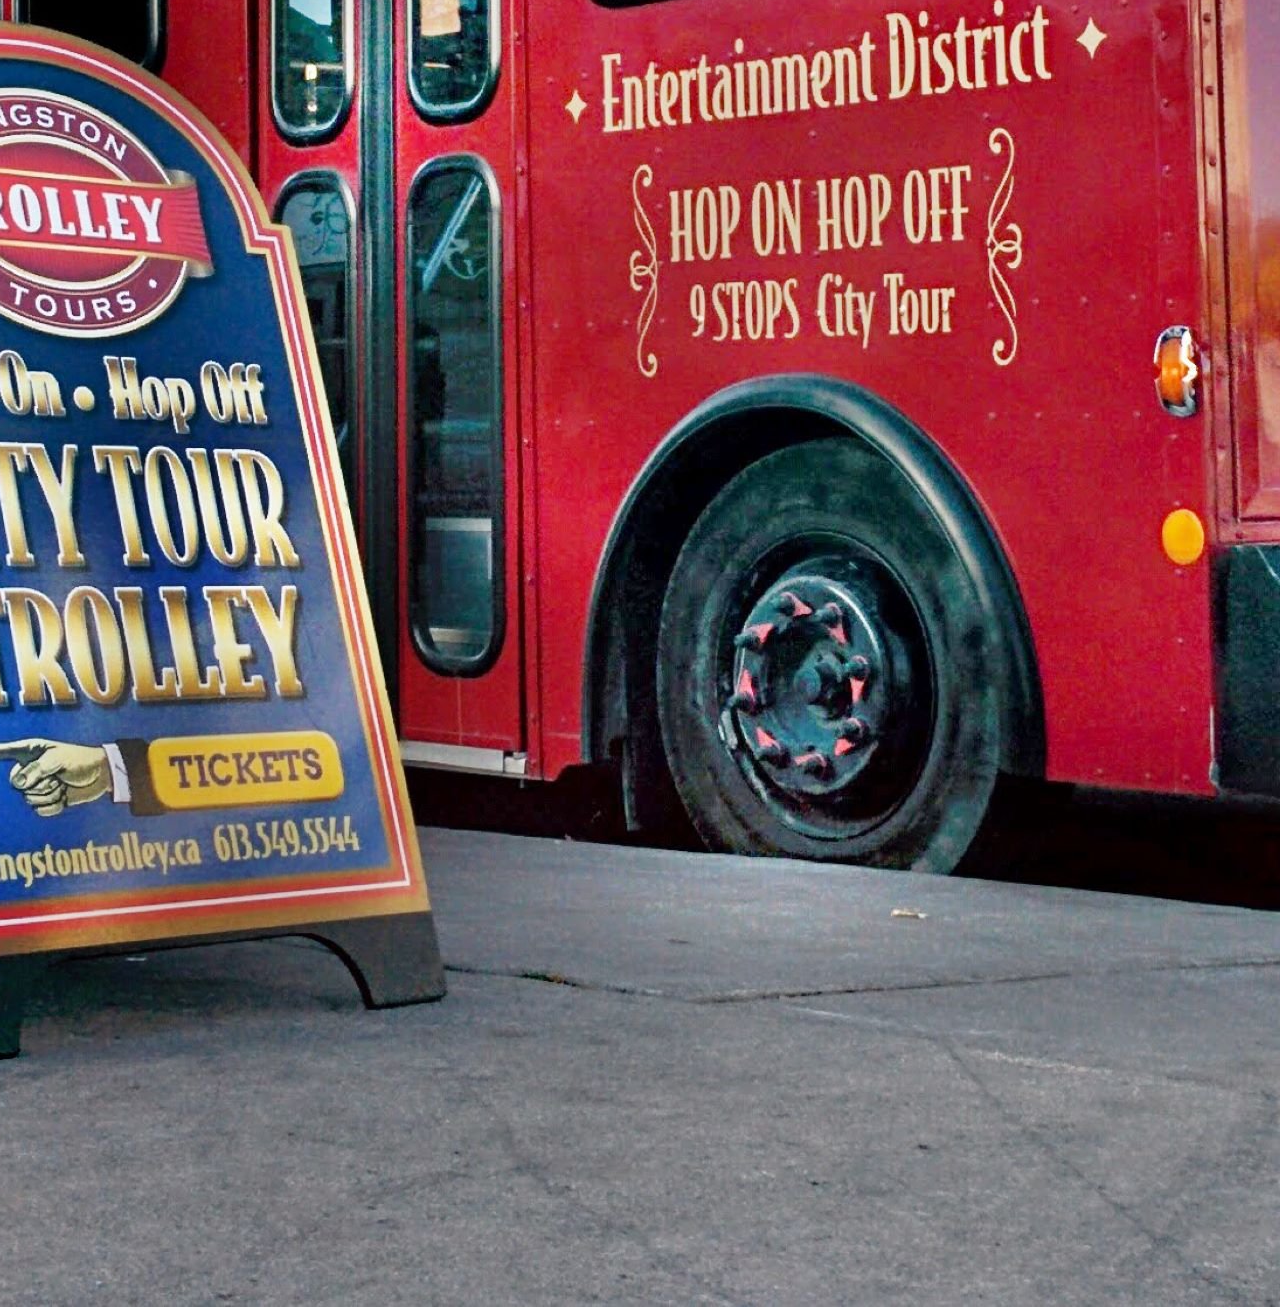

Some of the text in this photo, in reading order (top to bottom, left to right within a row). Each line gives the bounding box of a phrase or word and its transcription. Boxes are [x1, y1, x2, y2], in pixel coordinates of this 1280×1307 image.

[601, 0, 1052, 133] Entertainment District
[669, 165, 971, 263] HOP ON HOP OFF
[10, 282, 136, 321] TOURS
[690, 273, 955, 349] 9 STOPS City Tour
[103, 356, 195, 434] Hop
[200, 360, 267, 425] Off
[92, 445, 300, 568] TOUR
[169, 749, 323, 789] TICKETS
[213, 815, 360, 863] 613.549.5544
